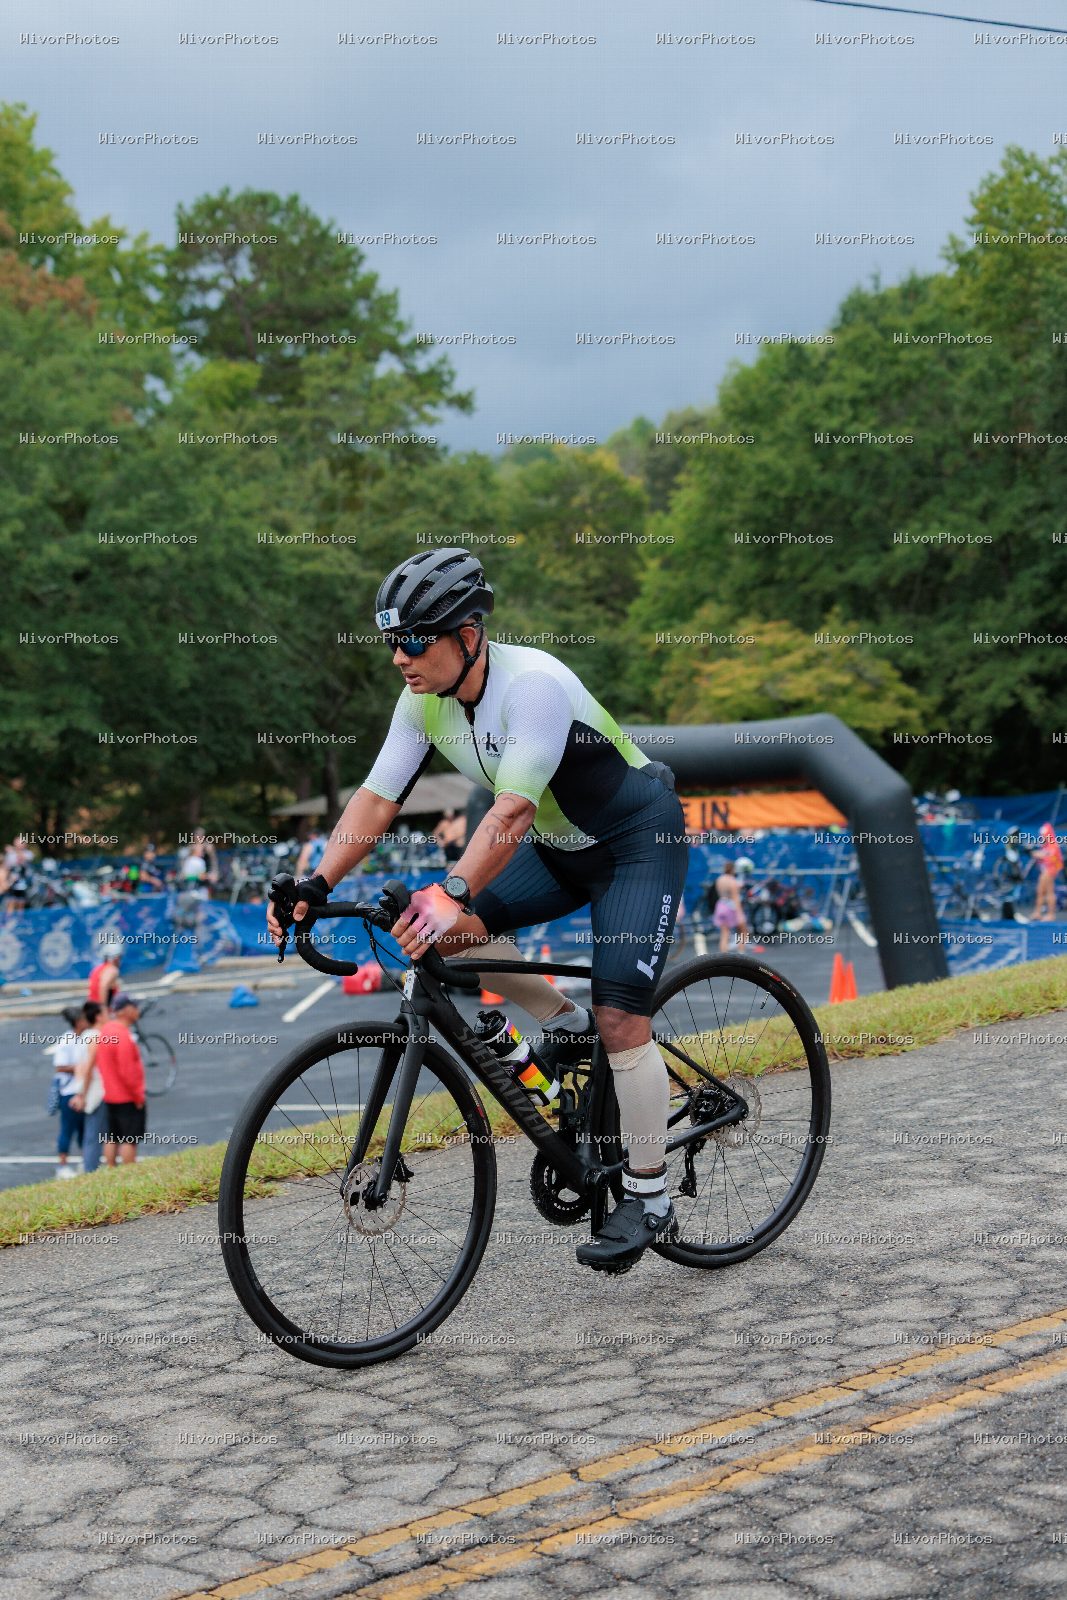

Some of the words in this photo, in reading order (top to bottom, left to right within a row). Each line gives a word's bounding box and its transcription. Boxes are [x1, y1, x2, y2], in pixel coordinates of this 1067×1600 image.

[380, 611, 391, 628] 29
[702, 801, 730, 829] IN
[452, 1025, 556, 1138] SPECIALIZED
[627, 1180, 638, 1190] 29
